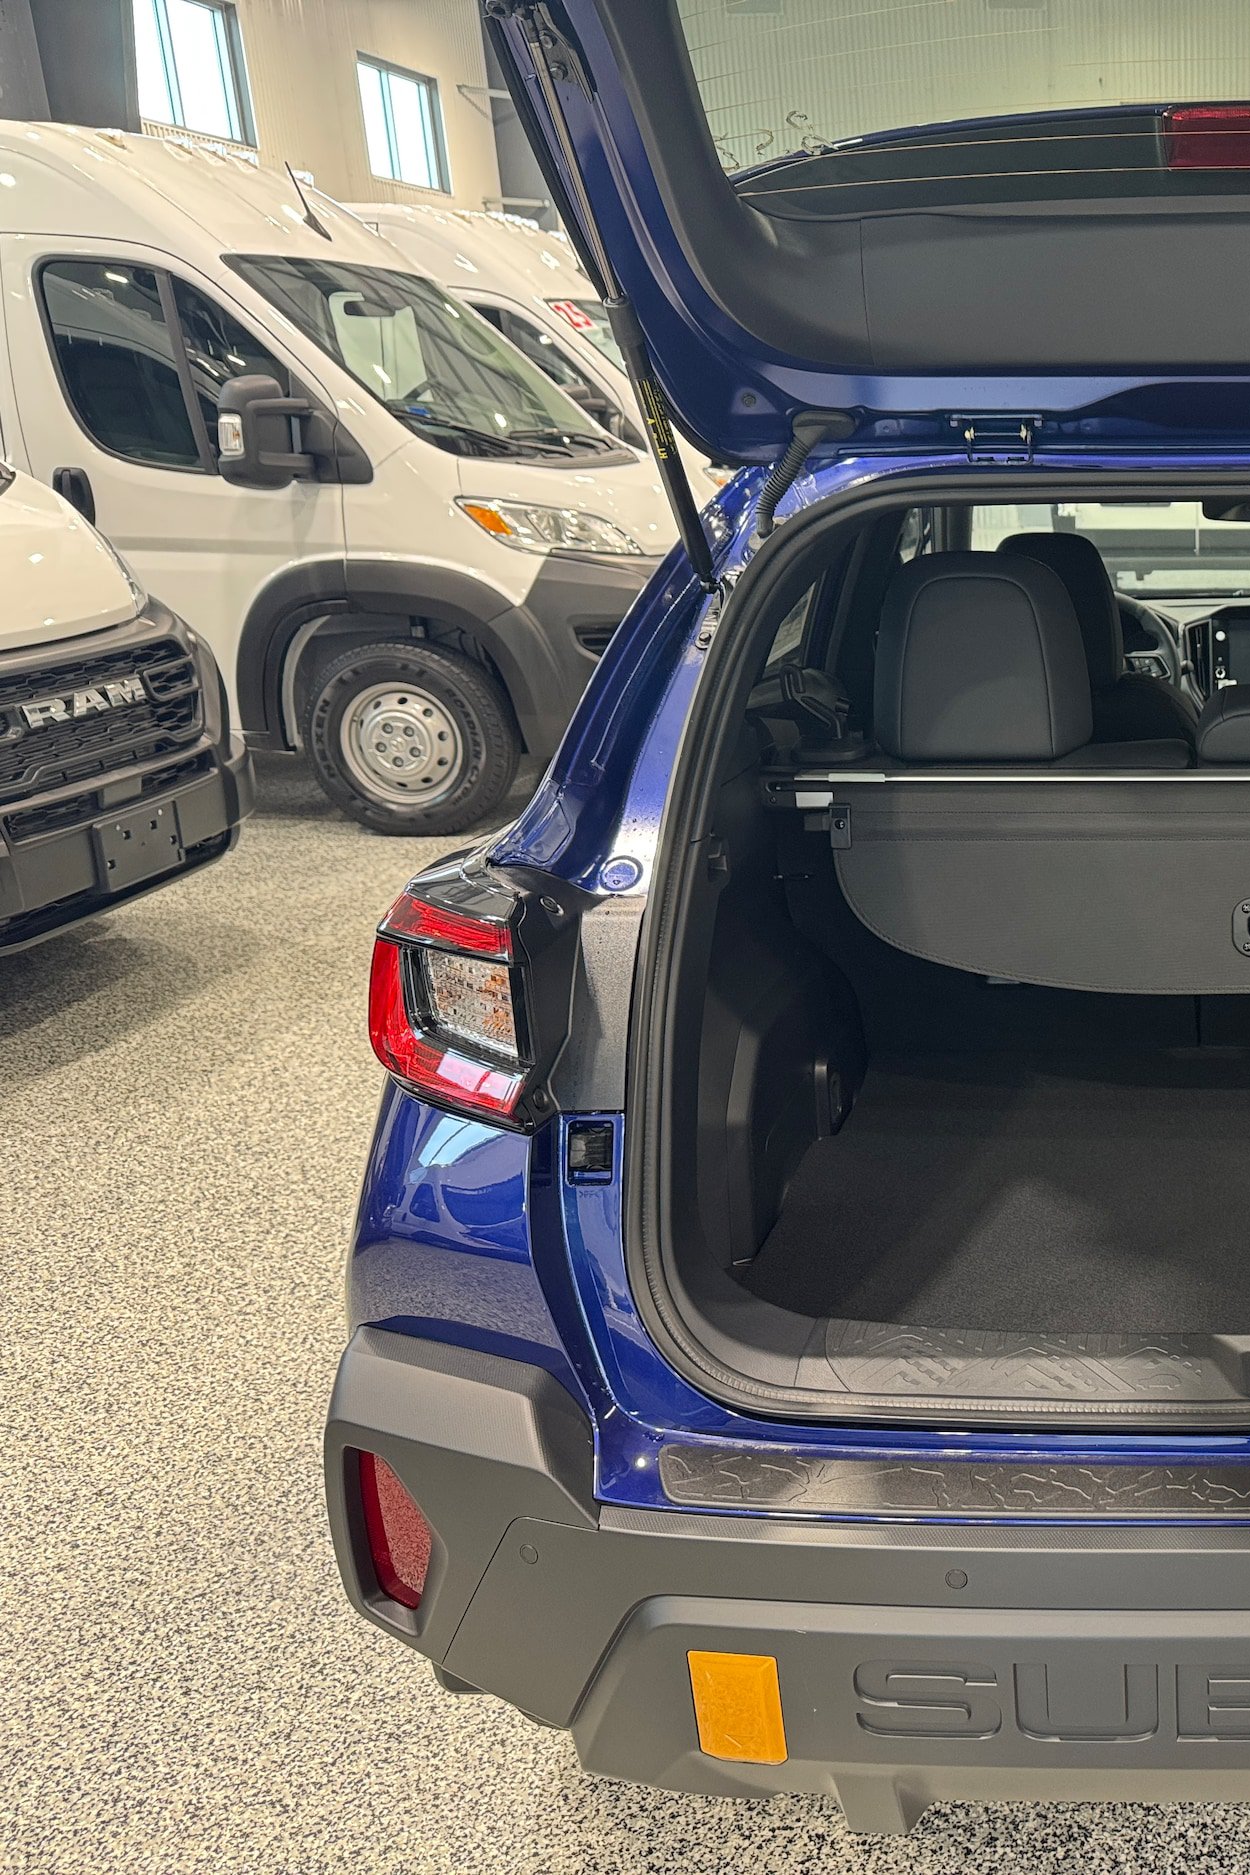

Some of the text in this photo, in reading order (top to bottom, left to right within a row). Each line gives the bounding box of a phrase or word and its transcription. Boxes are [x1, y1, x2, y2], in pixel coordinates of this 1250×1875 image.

[553, 301, 592, 328] 25
[658, 448, 669, 459] LH
[22, 678, 147, 728] RAM
[315, 698, 336, 778] NEXEN
